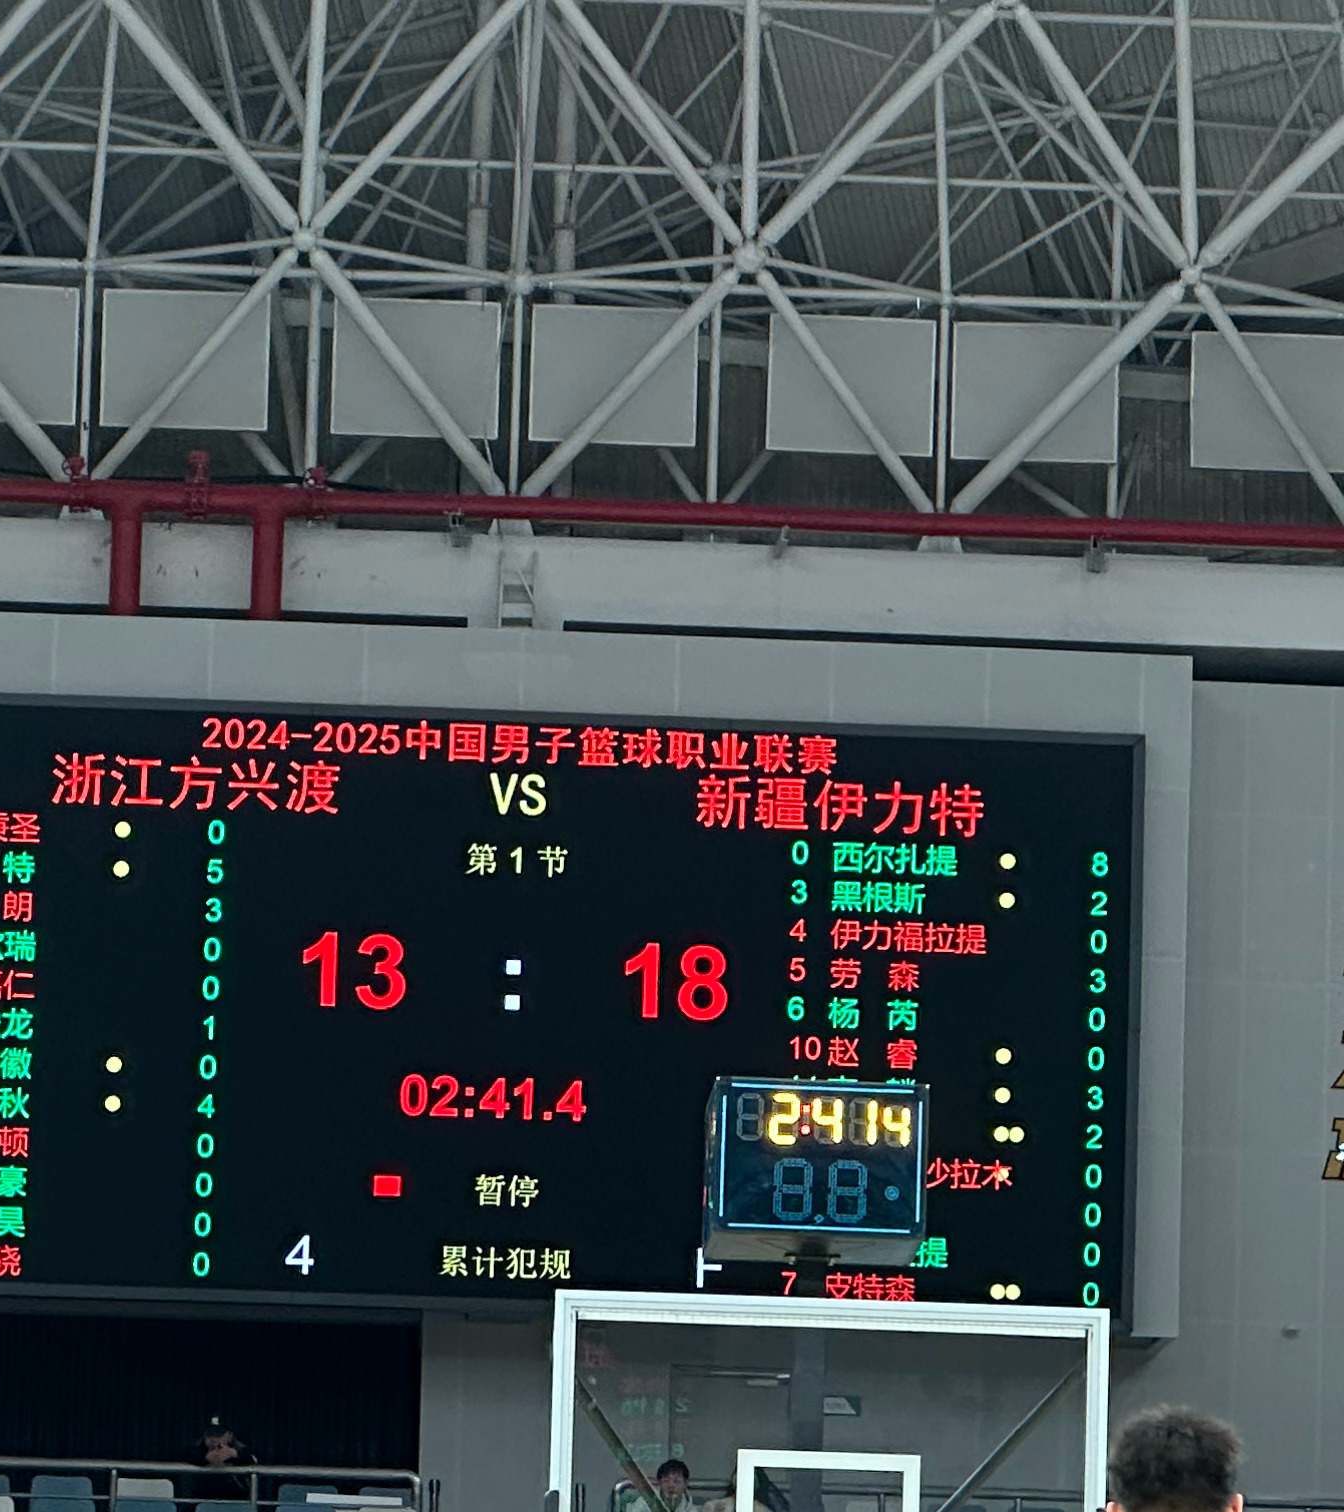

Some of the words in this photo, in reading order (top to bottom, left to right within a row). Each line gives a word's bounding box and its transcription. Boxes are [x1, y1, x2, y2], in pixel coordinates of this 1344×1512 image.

[202, 718, 837, 775] 2024-2025中国男子篮球职业联赛
[52, 753, 341, 815] 浙江方兴渡
[490, 773, 547, 816] VS
[696, 776, 985, 838] 新疆伊力特
[208, 820, 225, 844] 0
[792, 841, 808, 864] 0
[833, 842, 957, 876] 西尔扎提
[1092, 852, 1108, 876] 8
[207, 859, 223, 883] 5
[206, 898, 222, 922] 3
[791, 880, 807, 904] 3
[832, 881, 925, 914] 黑根斯
[1091, 891, 1107, 916] 2
[790, 919, 806, 942] 4
[831, 919, 986, 954] 伊力福拉提
[1091, 930, 1107, 953] 0
[204, 937, 221, 961] 0
[303, 932, 407, 1011] 13
[624, 943, 729, 1021] 18
[790, 958, 806, 981] 5
[1090, 969, 1106, 993] 3
[203, 976, 219, 1000] 0
[788, 996, 804, 1020] 6
[1089, 1008, 1105, 1031] 0
[204, 1016, 214, 1040] 1
[790, 1036, 821, 1060] 10
[1088, 1047, 1104, 1071] 0
[200, 1055, 216, 1079] 0
[198, 1094, 214, 1118] 4
[400, 1074, 587, 1123] 02:41.4
[1088, 1086, 1103, 1110] 3
[197, 1134, 214, 1158] 0
[1086, 1125, 1102, 1149] 2
[196, 1173, 212, 1197] 0
[1086, 1164, 1102, 1188] 0
[476, 1174, 539, 1208] 暂停
[195, 1212, 211, 1236] 0
[1085, 1203, 1101, 1227] 0
[193, 1252, 209, 1276] 0
[284, 1235, 315, 1275] 4
[441, 1246, 571, 1280] 累计犯规
[1084, 1242, 1100, 1266] 0
[1083, 1281, 1099, 1305] 0
